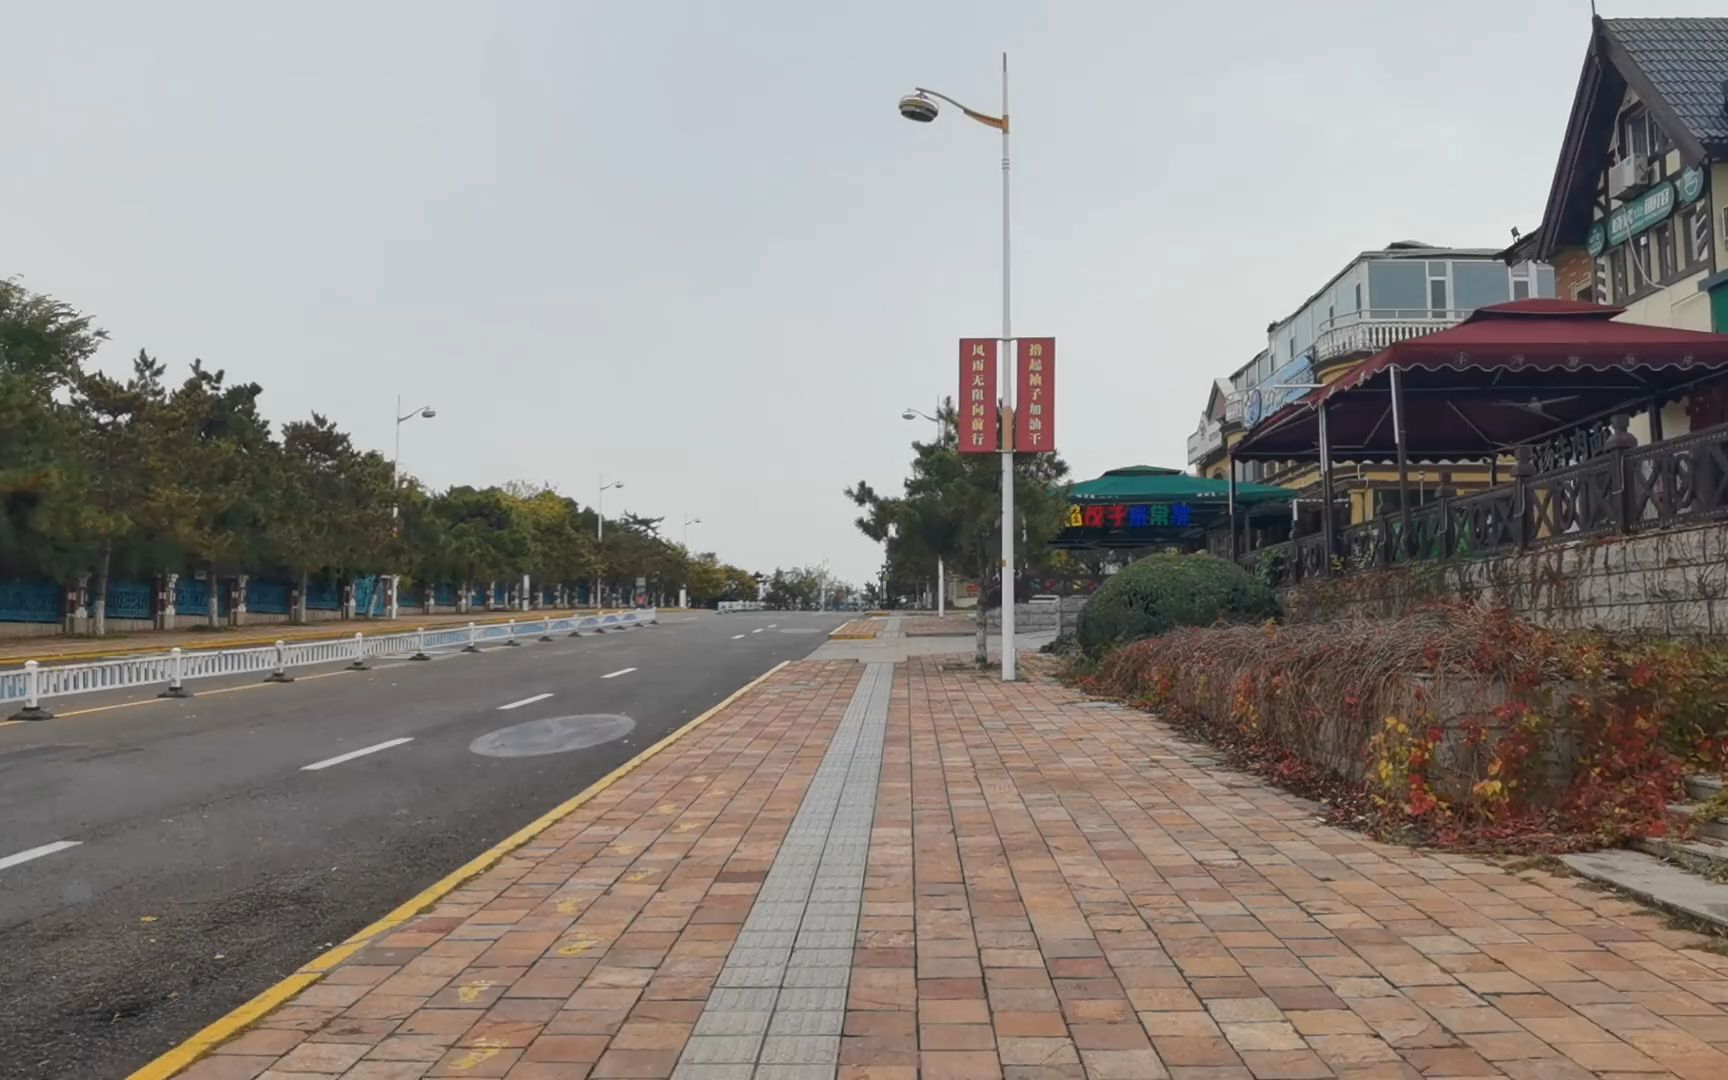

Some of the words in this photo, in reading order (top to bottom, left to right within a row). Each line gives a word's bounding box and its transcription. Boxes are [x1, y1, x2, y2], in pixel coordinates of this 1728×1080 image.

[971, 343, 985, 445] 风雨无阻向前行
[1029, 343, 1042, 445] 撸起袖子加油干
